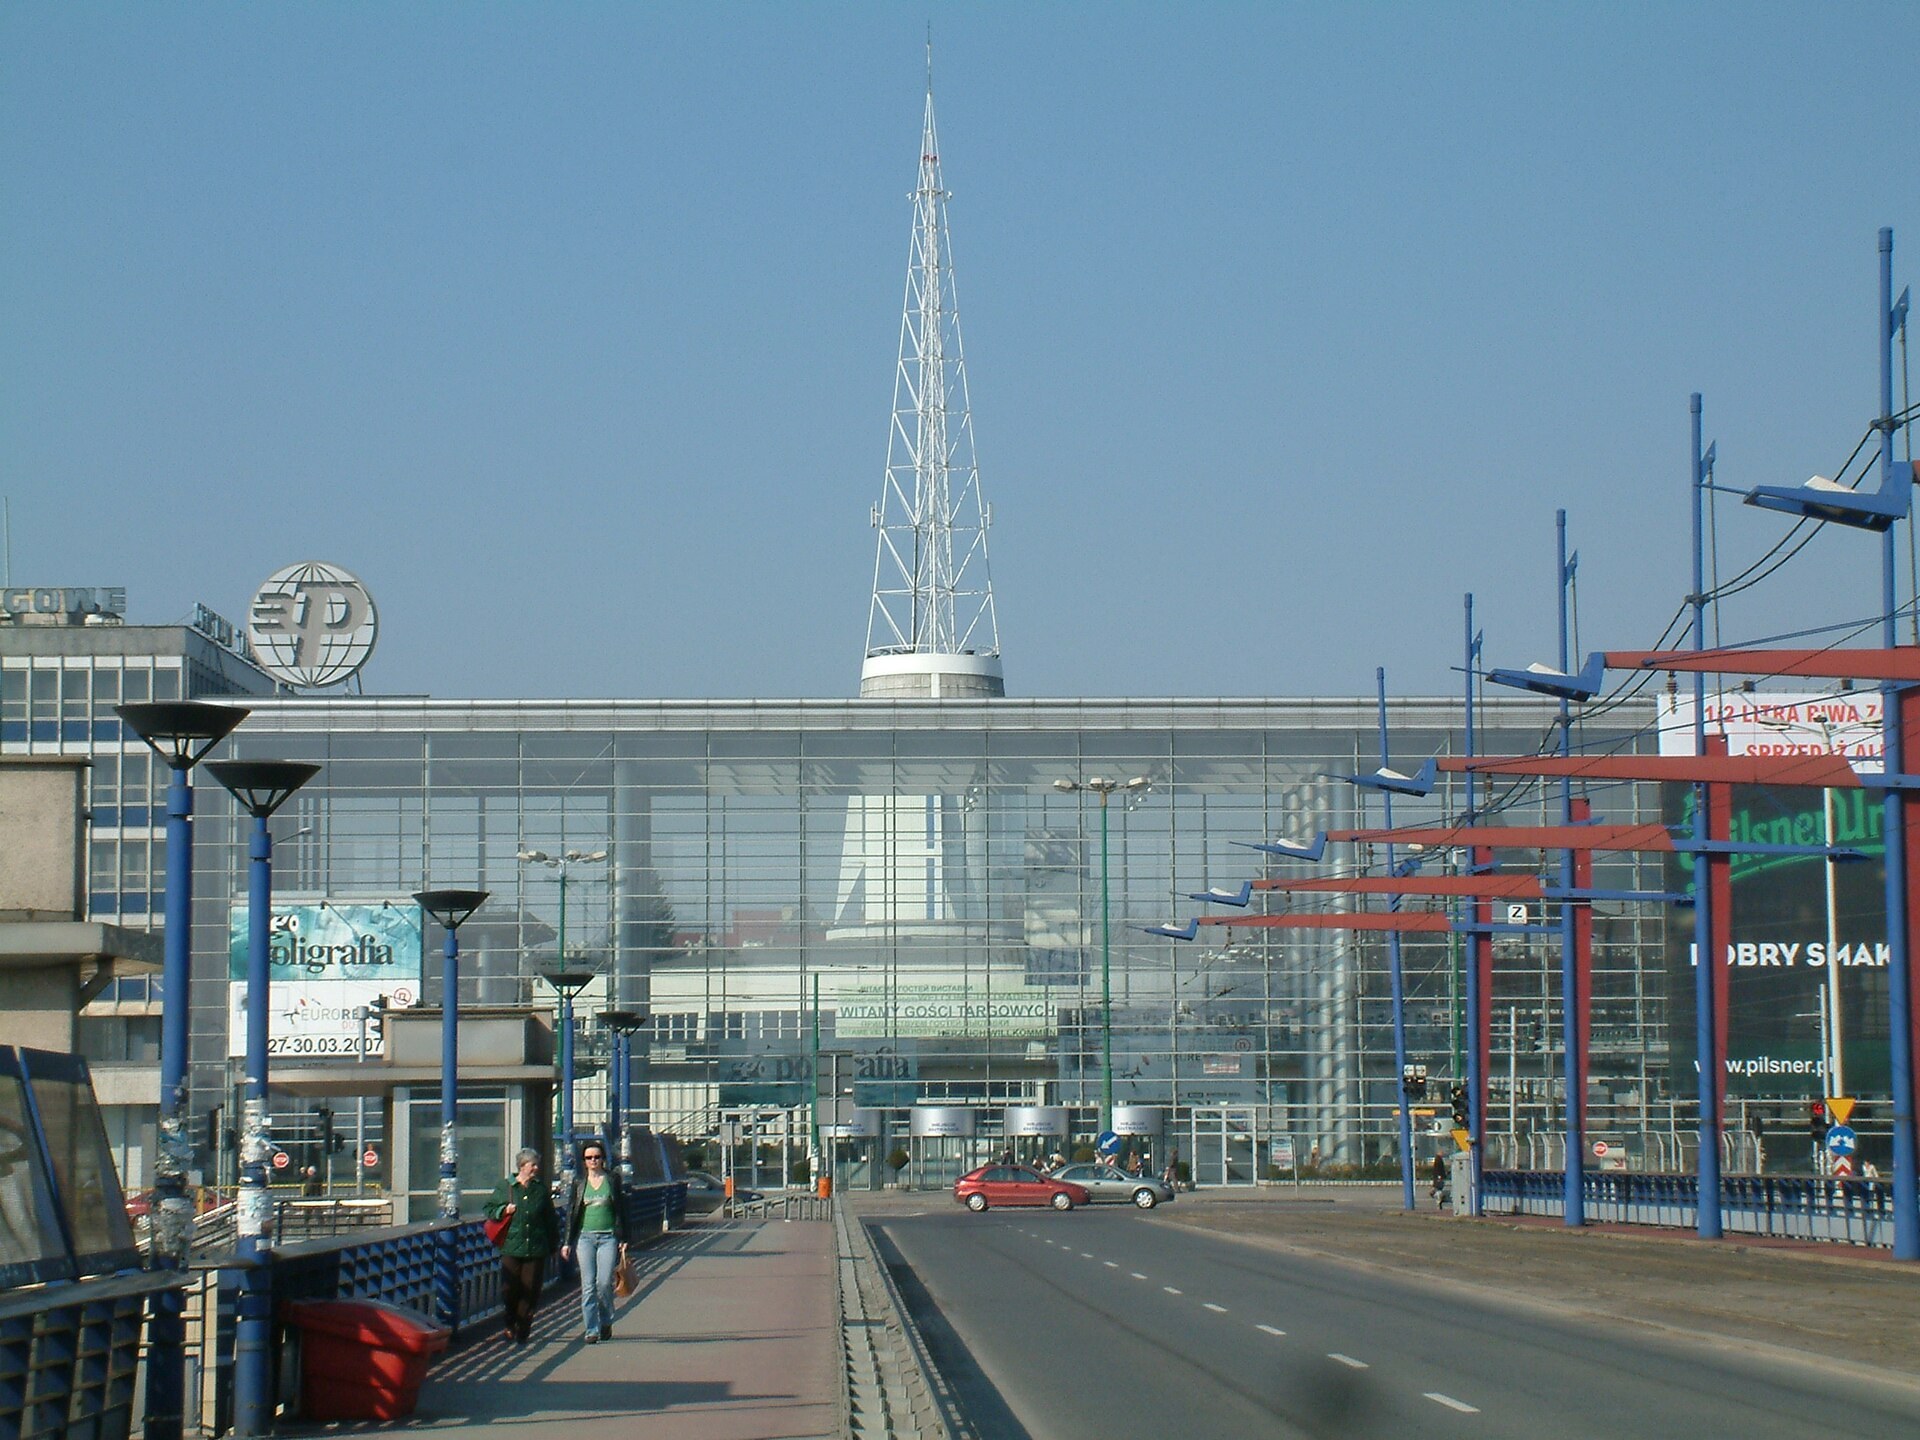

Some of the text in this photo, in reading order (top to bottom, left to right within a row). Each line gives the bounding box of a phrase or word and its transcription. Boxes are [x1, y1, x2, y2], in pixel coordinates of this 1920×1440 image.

[1742, 704, 1799, 724] LITRA
[1512, 906, 1523, 918] Z
[905, 1003, 951, 1017] GOŚCI
[957, 1005, 1055, 1017] TARGOWYCH
